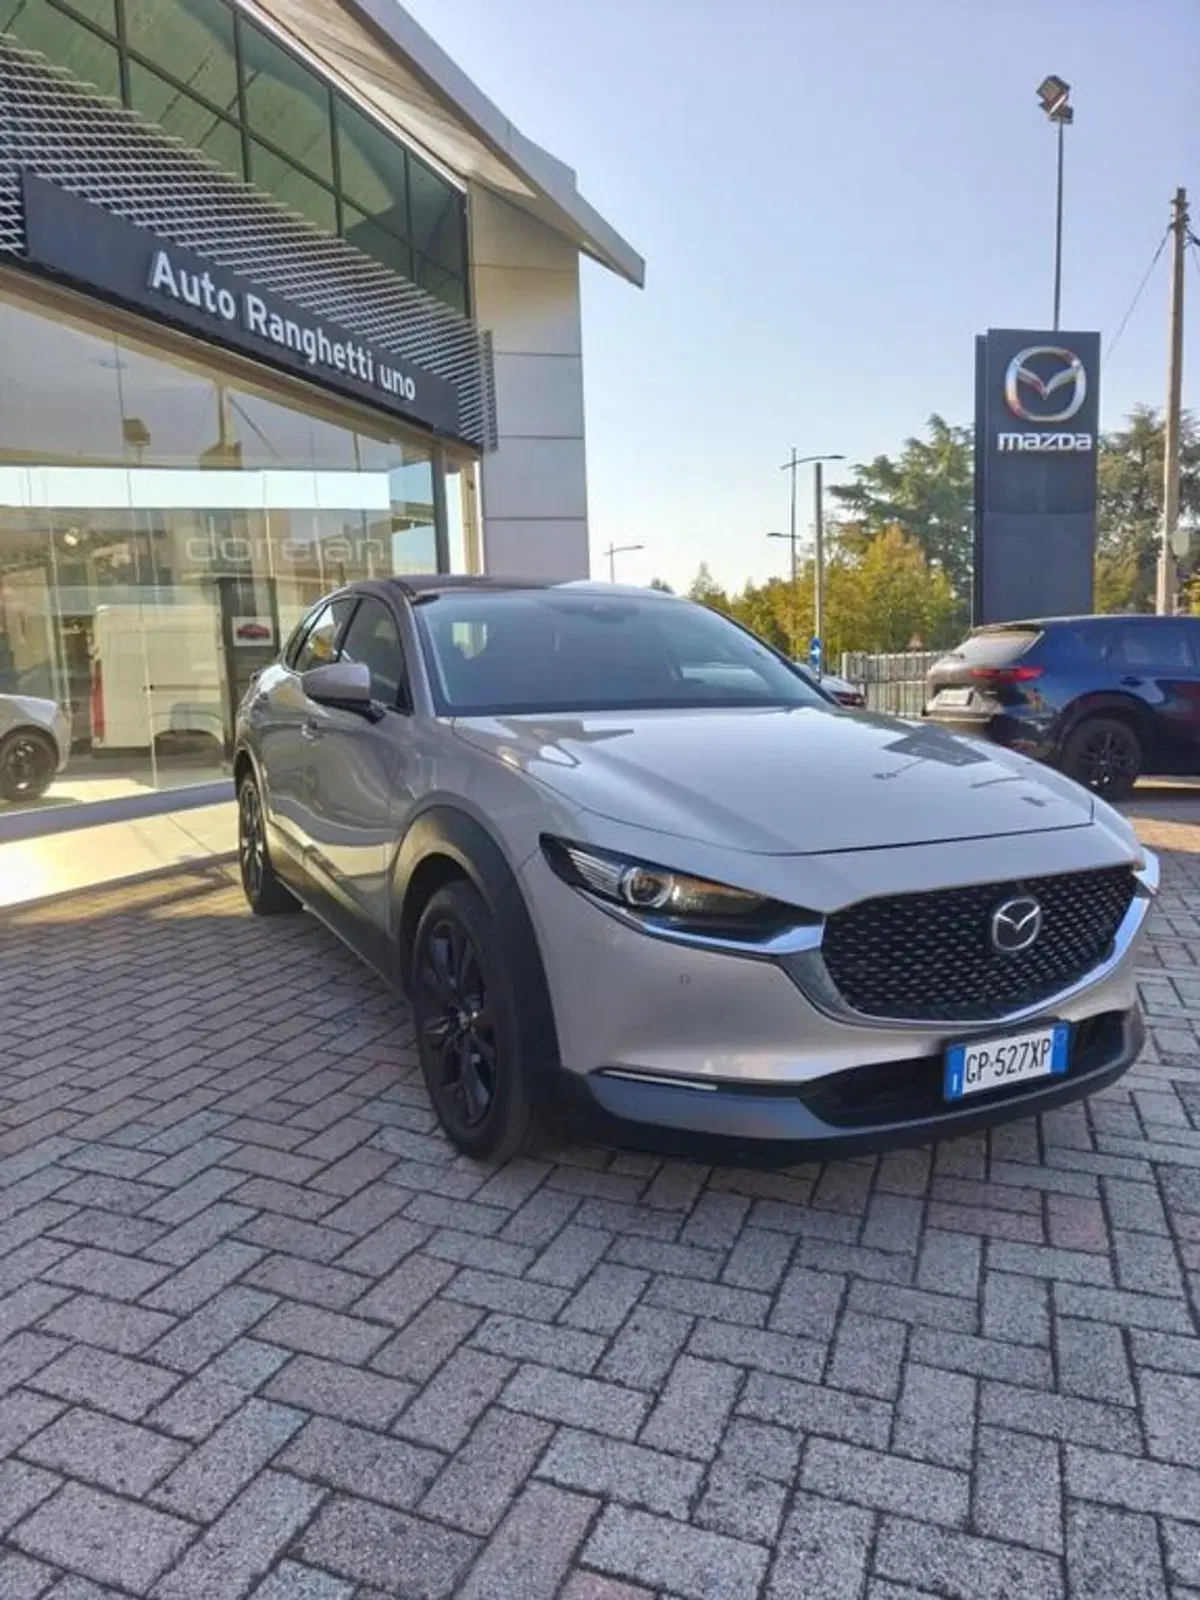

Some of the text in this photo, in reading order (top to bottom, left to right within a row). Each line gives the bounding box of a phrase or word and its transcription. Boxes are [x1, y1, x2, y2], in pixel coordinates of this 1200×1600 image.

[149, 250, 416, 400] Auto Ranghetti uno
